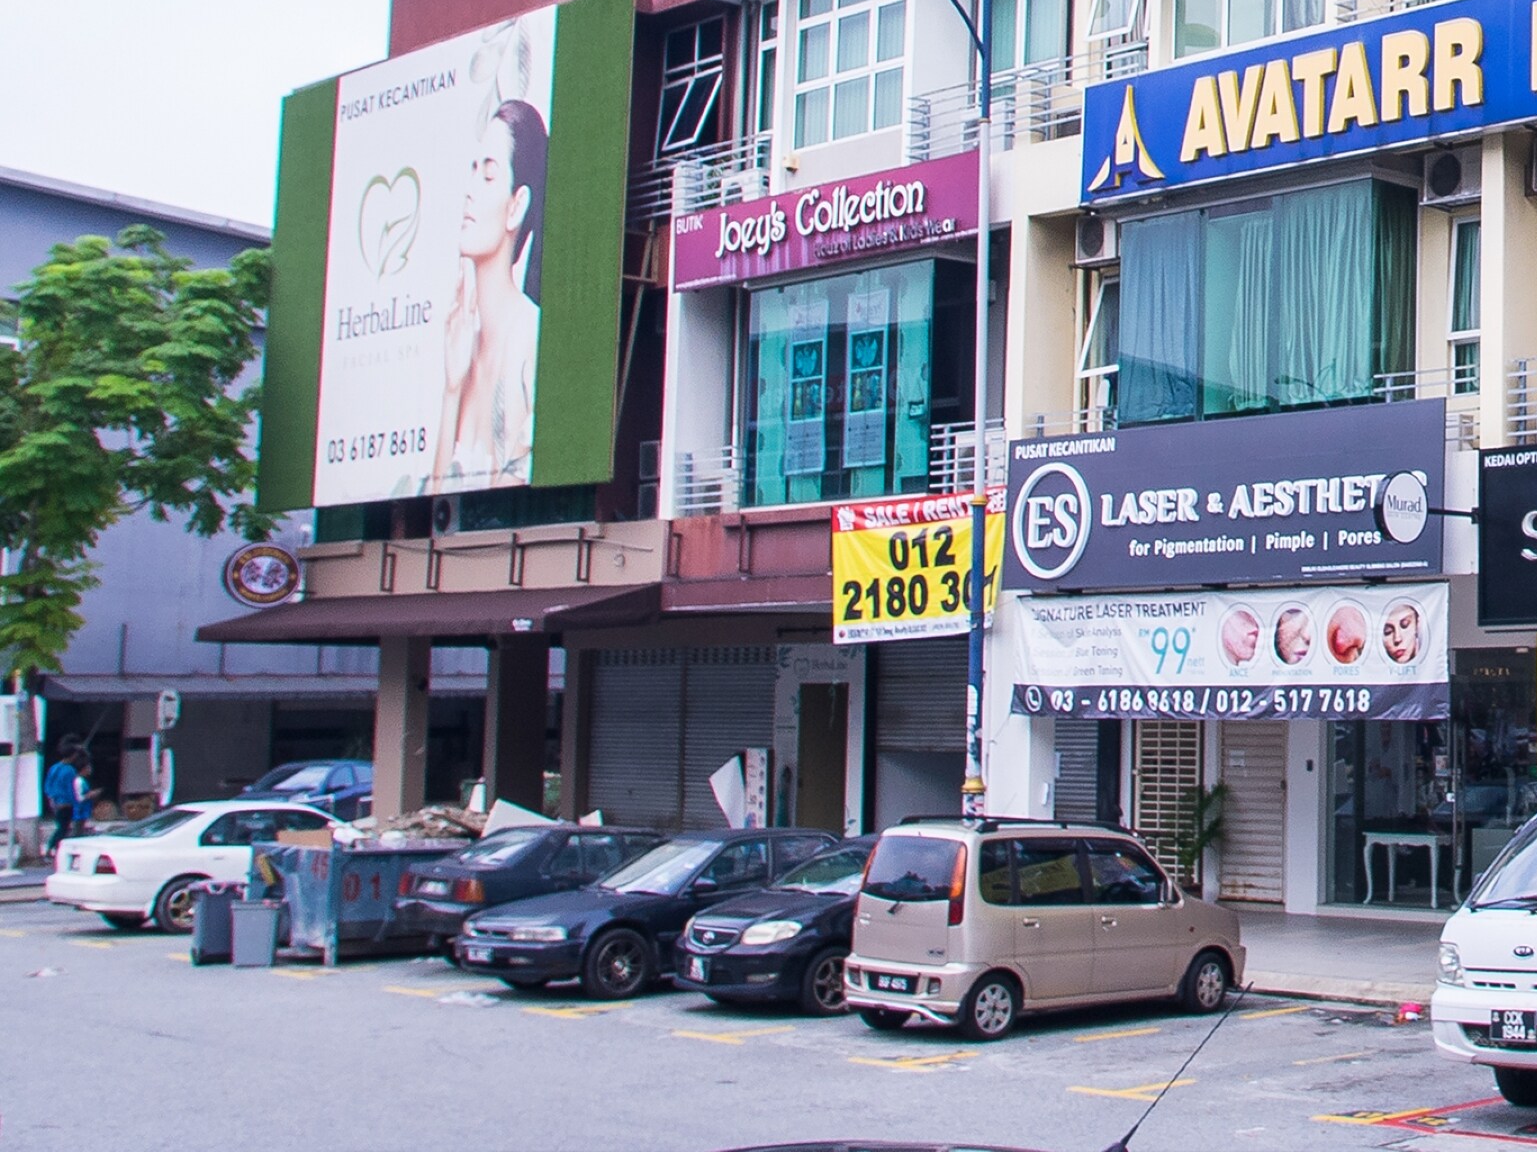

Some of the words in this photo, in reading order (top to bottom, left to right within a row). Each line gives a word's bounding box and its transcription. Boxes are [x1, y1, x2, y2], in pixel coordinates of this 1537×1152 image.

[340, 95, 375, 122] PUSAT
[379, 69, 457, 109] KECANTIKAN
[1180, 16, 1483, 162] AVATARR
[676, 214, 704, 235] BUTIK
[715, 200, 787, 258] Joey's
[795, 180, 926, 236] Collection
[337, 293, 433, 341] HerbaLine
[327, 438, 345, 464] 03
[350, 433, 386, 461] 6187
[390, 427, 427, 456] 8618
[1015, 443, 1049, 459] PUSAT
[1049, 437, 1116, 457] KECANTIKAN
[1484, 454, 1515, 468] KEDAI
[864, 503, 910, 529] SALE
[1101, 488, 1200, 527] LASER
[1207, 492, 1224, 514] &
[1228, 470, 1428, 520] AESTHET
[1027, 493, 1078, 549] ES
[889, 525, 956, 572] 012
[1129, 539, 1151, 557] for
[1155, 534, 1245, 558] Pigmentation
[1265, 531, 1315, 553] Pimple
[1338, 530, 1382, 547] Pores
[843, 574, 929, 622] 2180
[1096, 603, 1132, 619] LASER
[1136, 601, 1207, 617] TREATMENT
[1151, 626, 1191, 675] 99
[1333, 666, 1361, 676] PORES
[1051, 690, 1074, 712] 03
[1098, 689, 1143, 711] 6186
[1216, 689, 1251, 711] 012
[1274, 689, 1312, 711] 517
[1319, 689, 1371, 712] 7618
